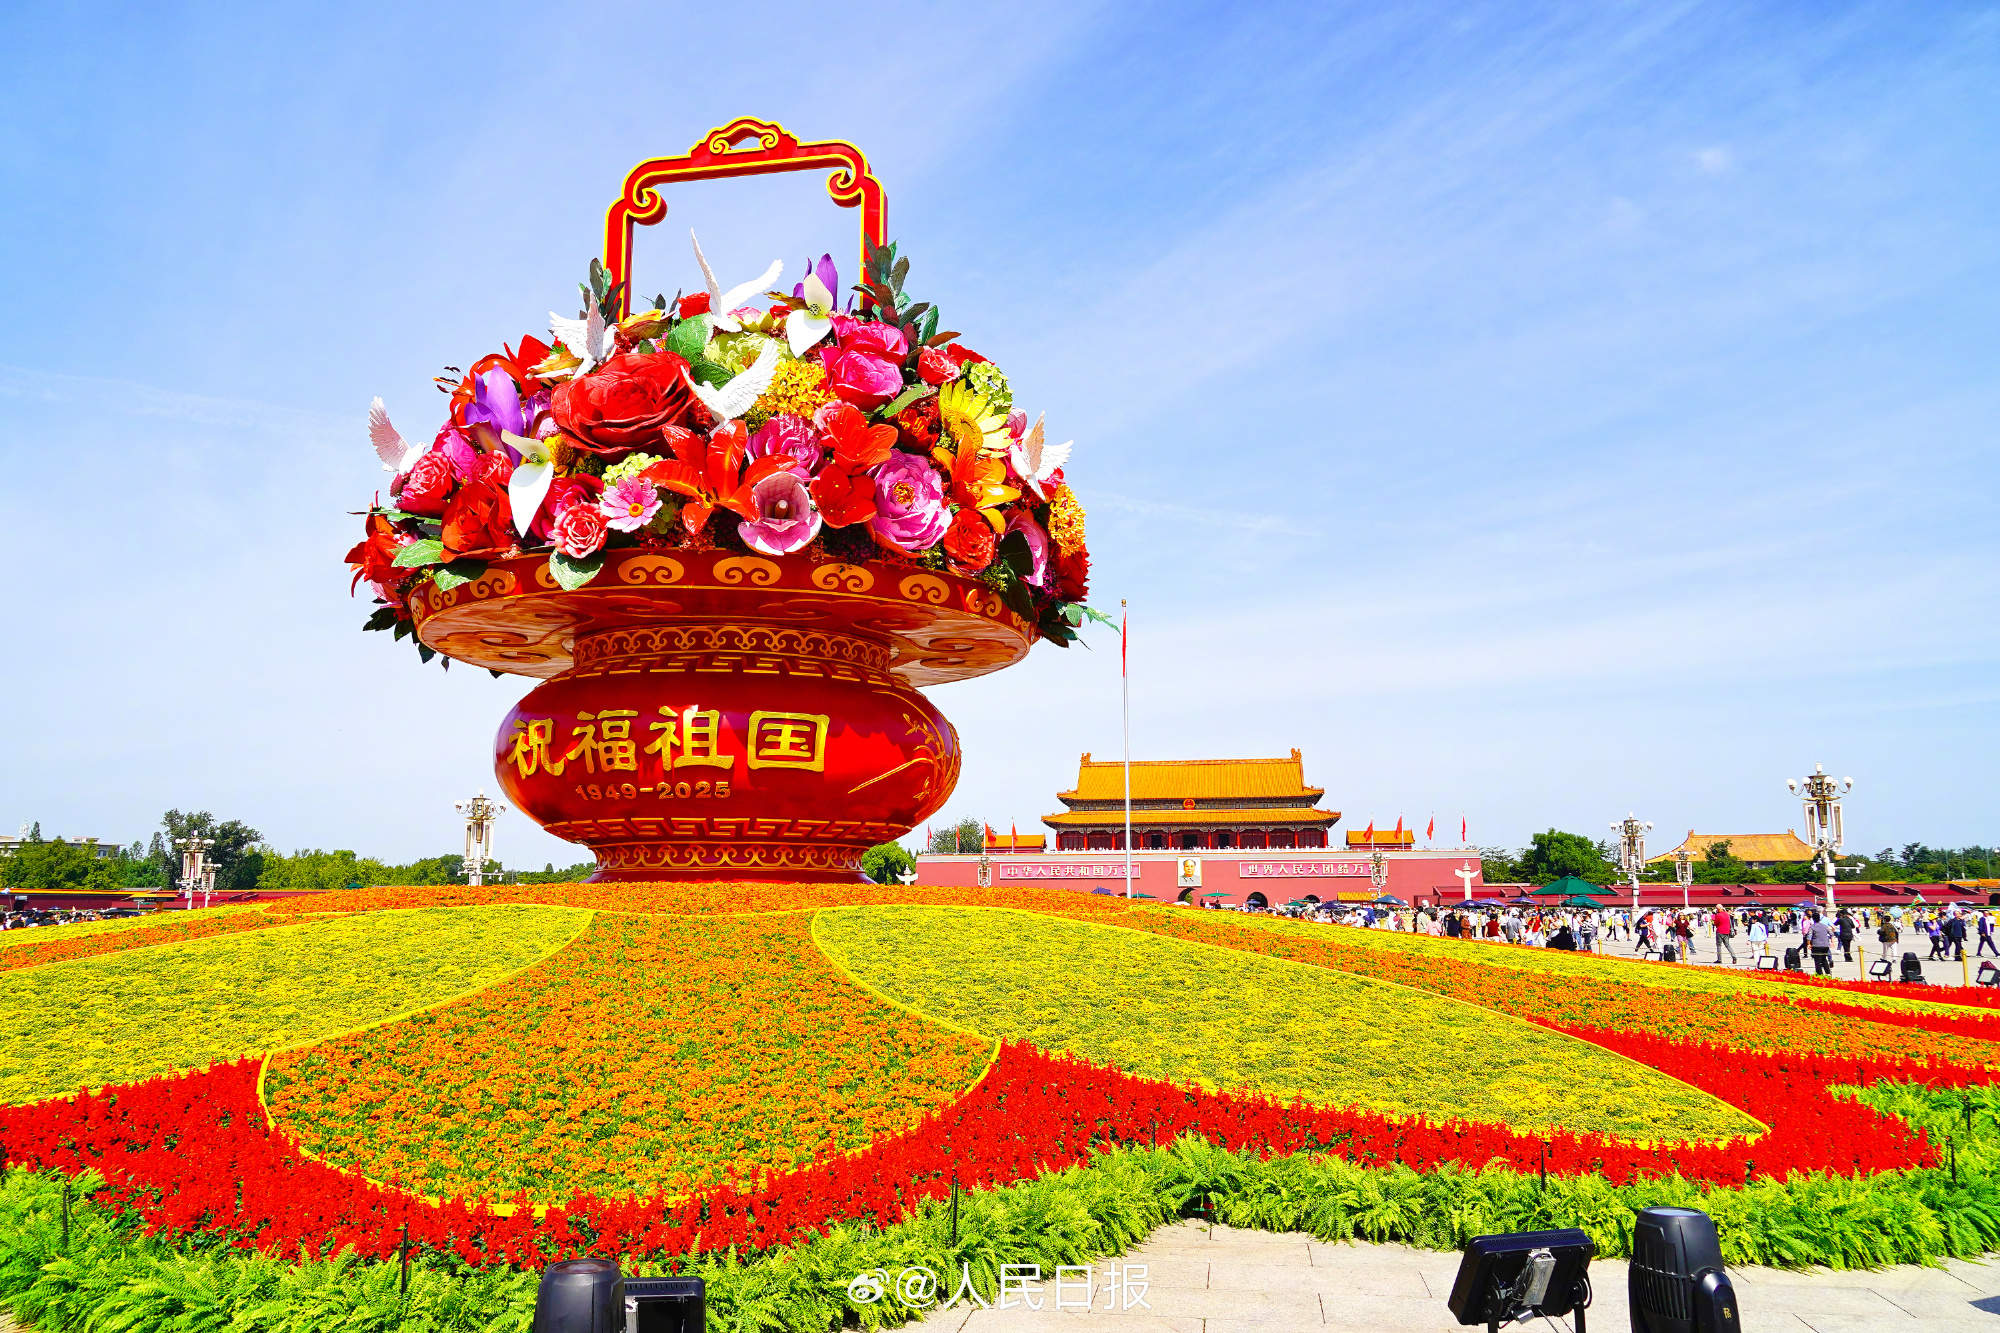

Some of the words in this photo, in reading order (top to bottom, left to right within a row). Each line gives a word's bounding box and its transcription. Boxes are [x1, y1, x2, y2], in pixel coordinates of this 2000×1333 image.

[506, 705, 830, 779] 祝福祖国
[575, 781, 731, 800] 1949-2025
